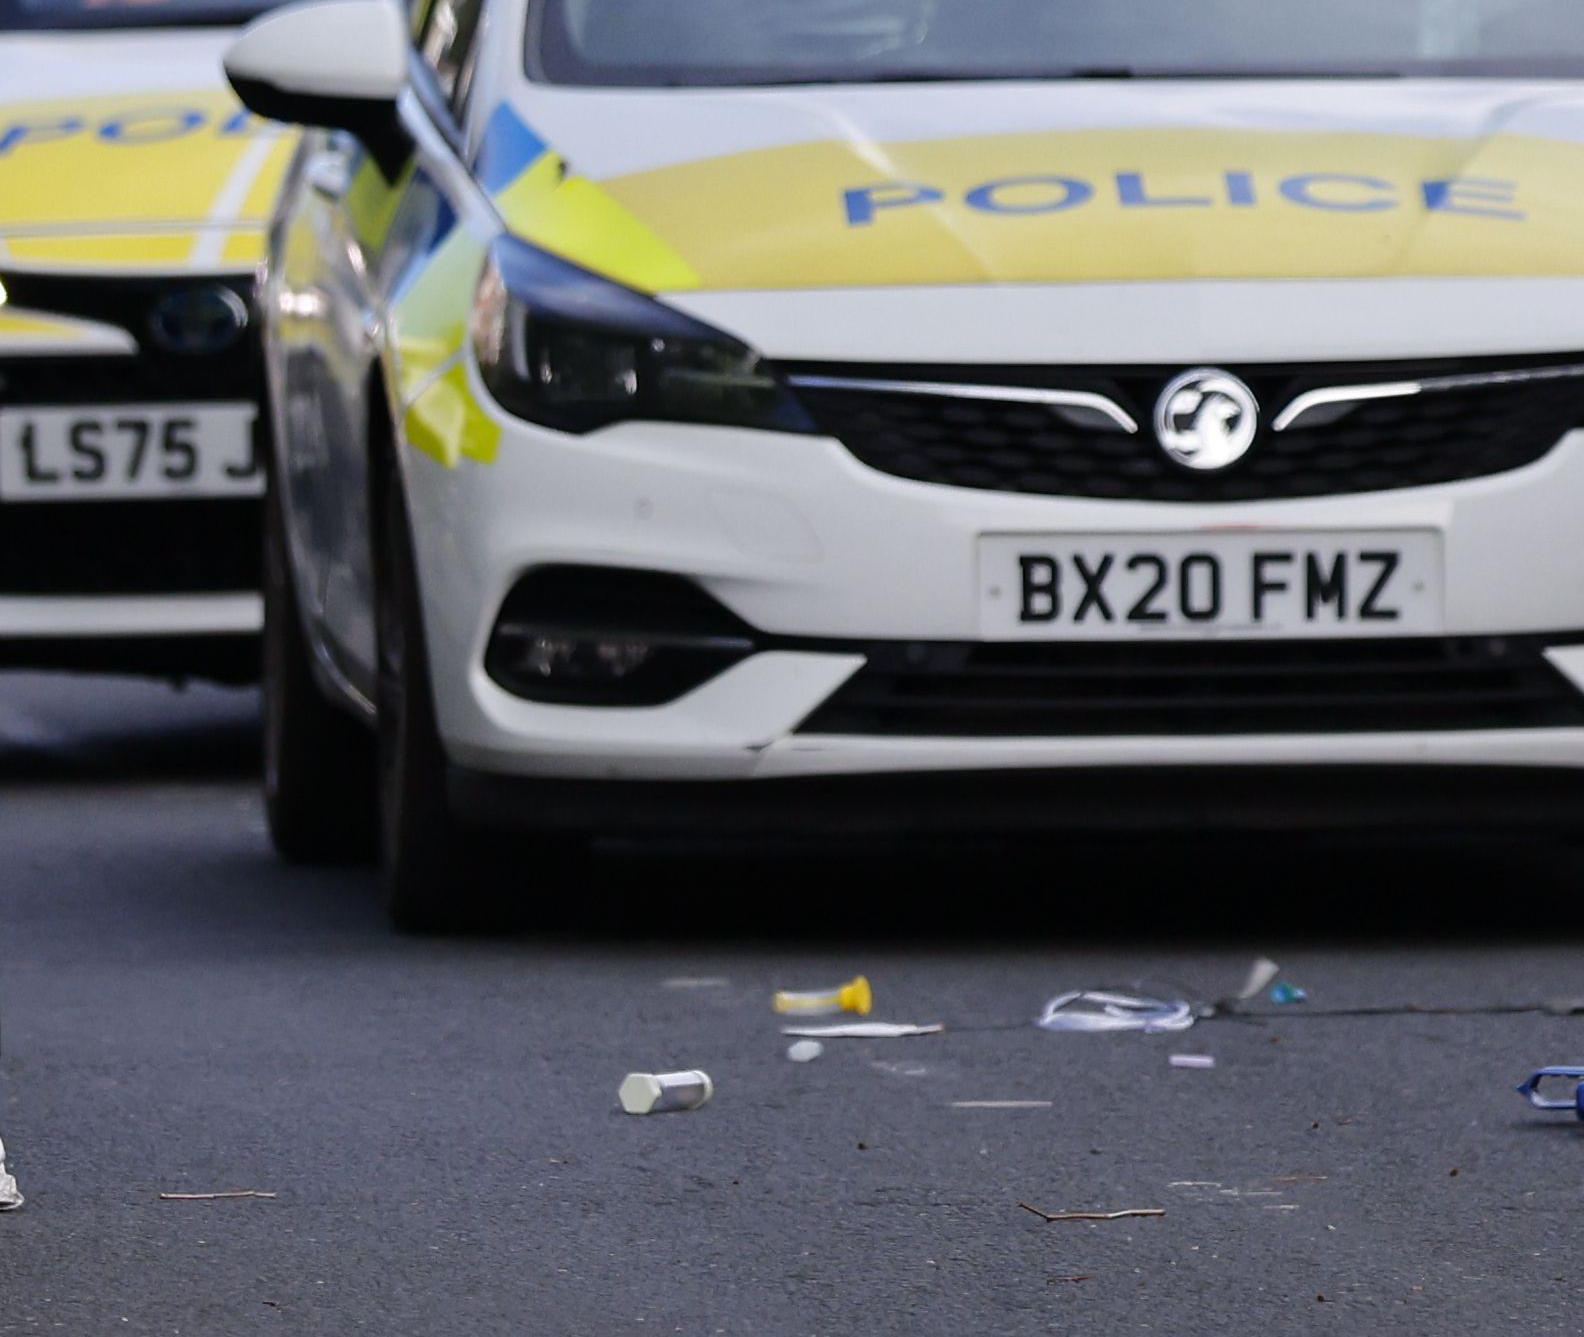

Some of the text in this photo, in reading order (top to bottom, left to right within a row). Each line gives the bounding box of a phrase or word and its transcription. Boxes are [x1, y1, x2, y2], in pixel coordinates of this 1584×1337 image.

[843, 170, 1526, 227] POLICE
[20, 420, 198, 484] LS75
[1018, 550, 1401, 623] BX20 FMZ
